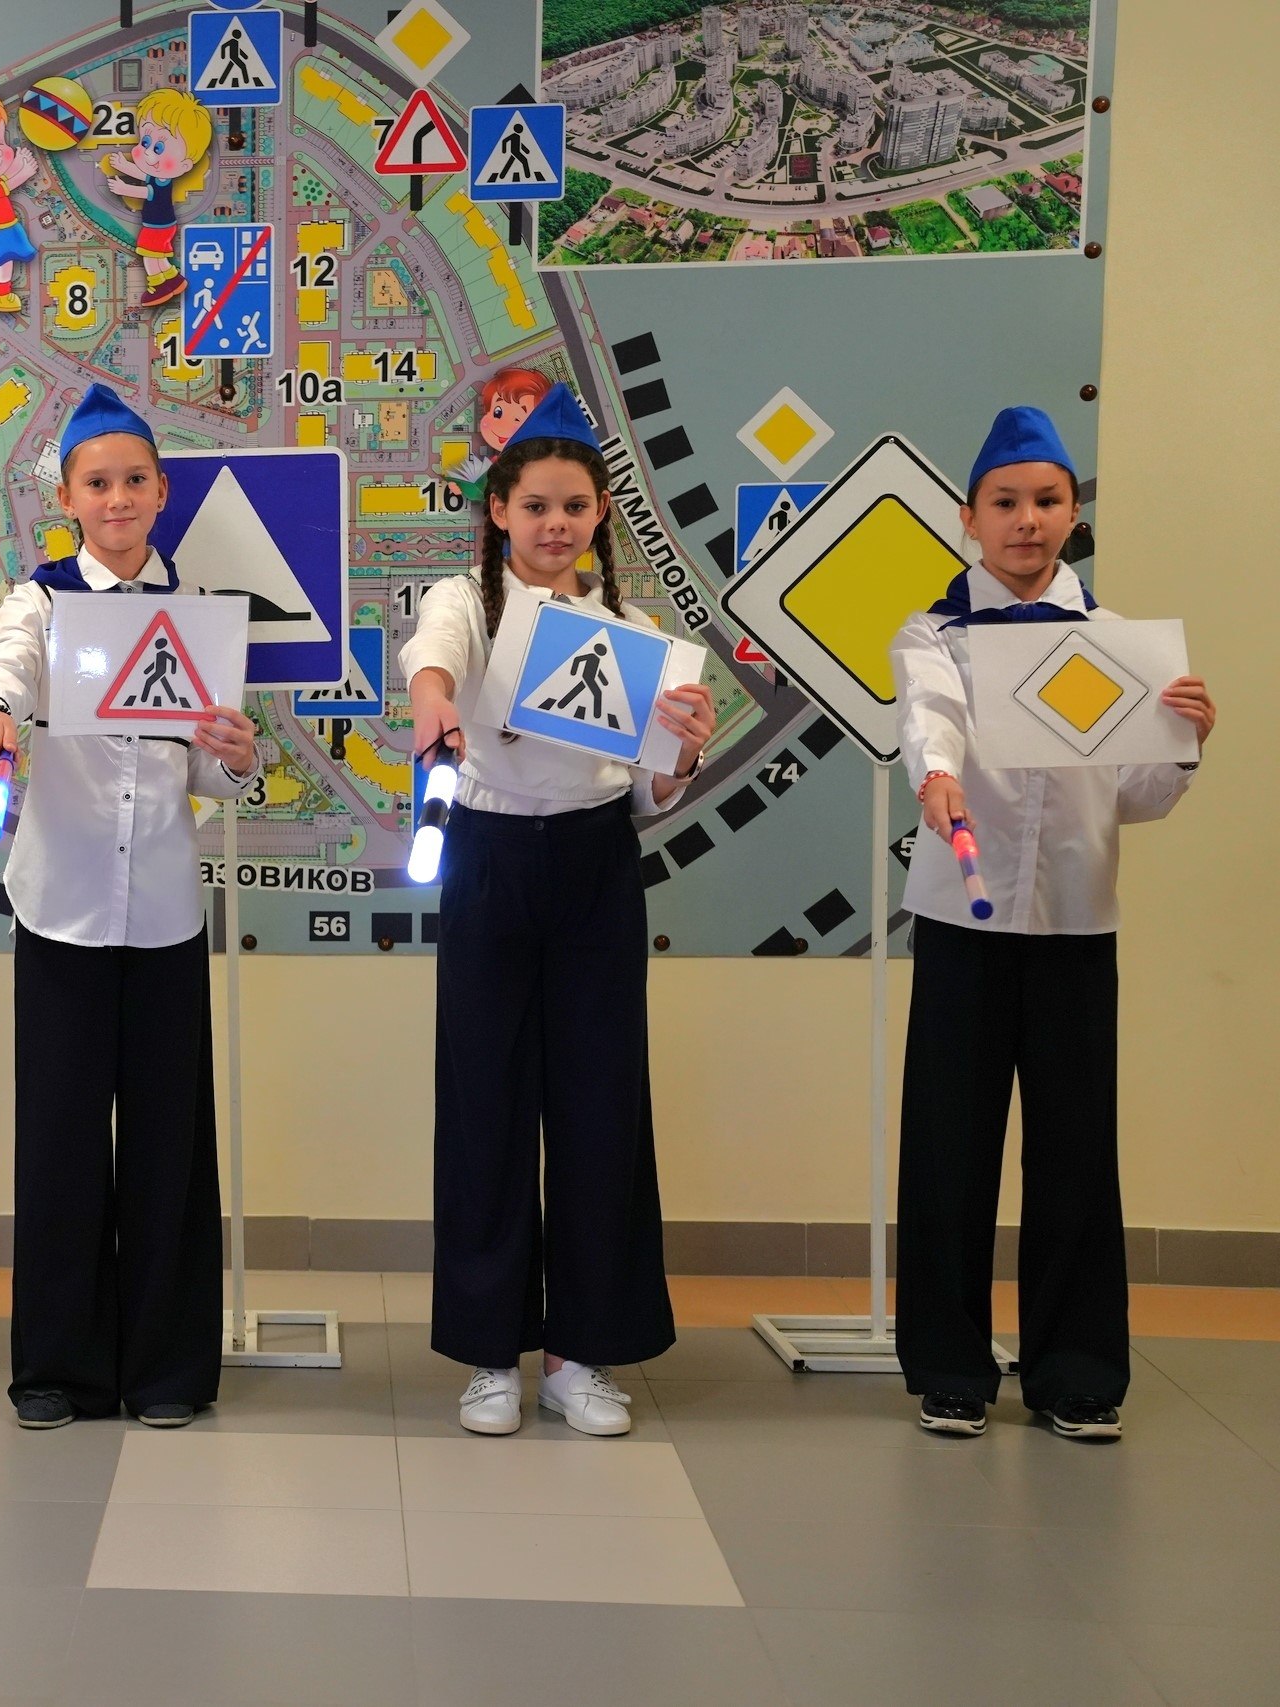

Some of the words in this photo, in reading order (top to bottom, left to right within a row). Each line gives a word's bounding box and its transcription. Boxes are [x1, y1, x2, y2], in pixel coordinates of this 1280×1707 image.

[293, 256, 334, 287] 12
[68, 285, 88, 315] 8
[374, 351, 417, 383] 14
[422, 481, 464, 512] 16
[765, 763, 800, 784] 74
[312, 916, 347, 937] 56
